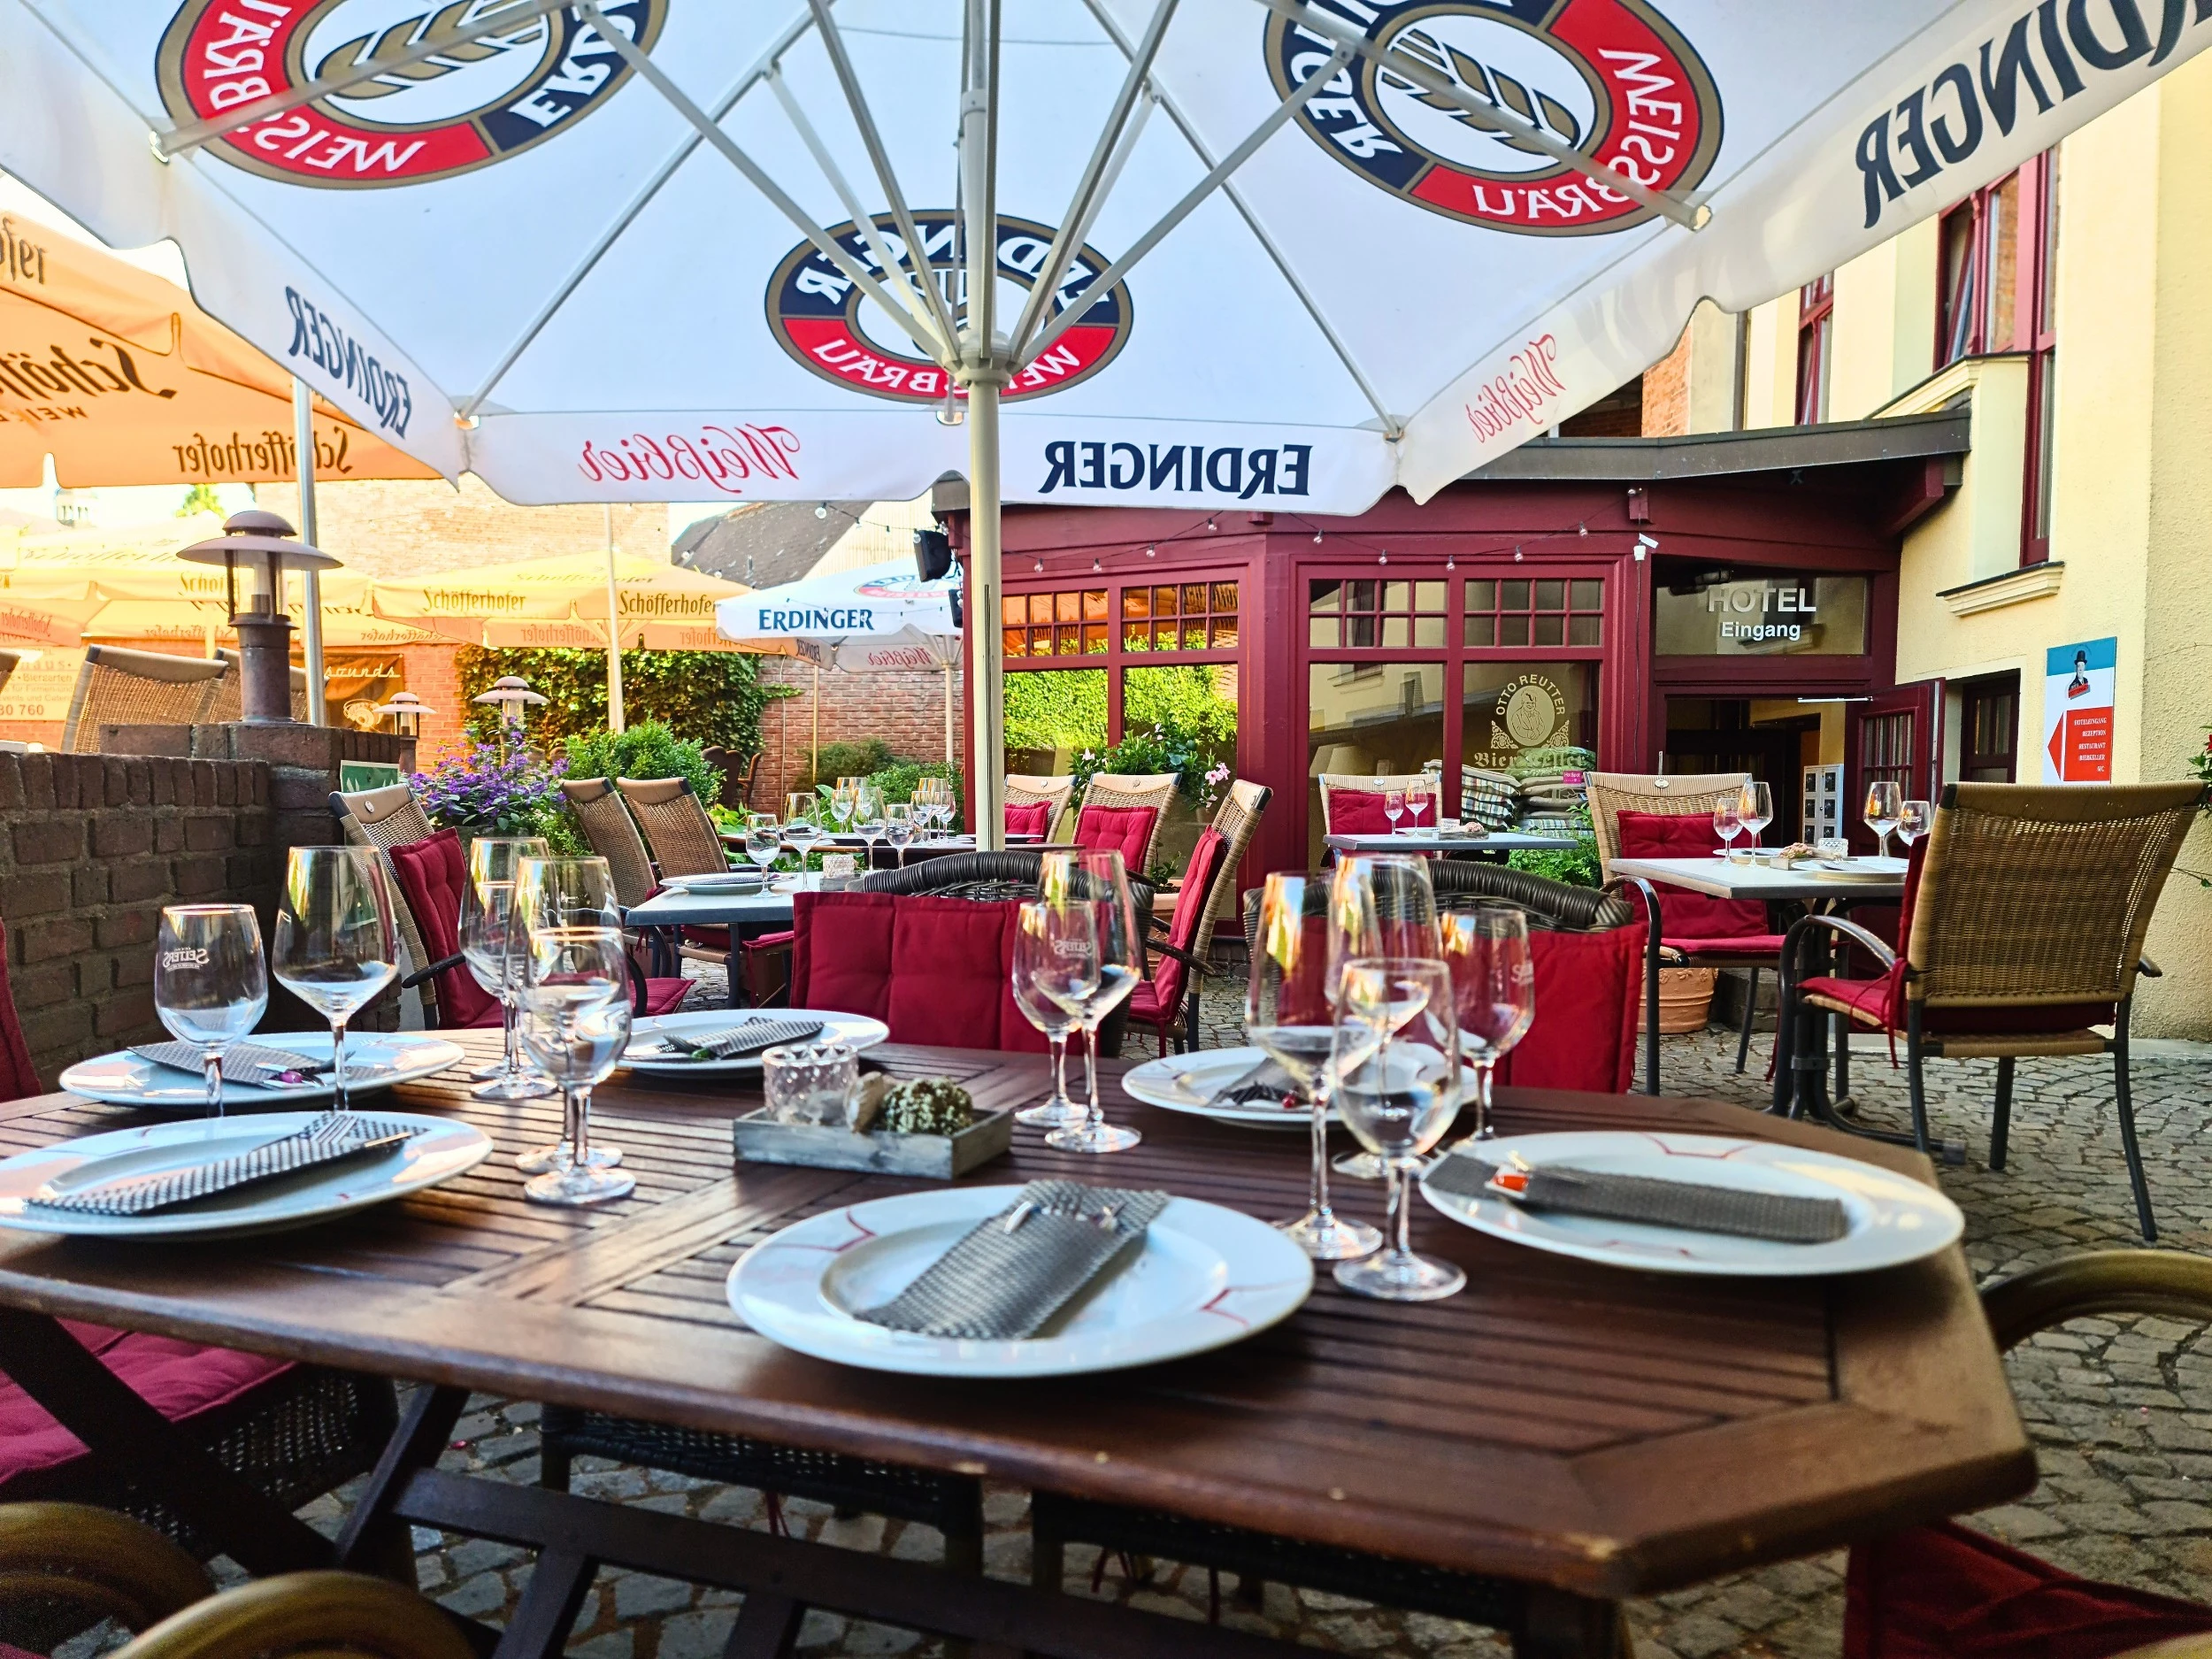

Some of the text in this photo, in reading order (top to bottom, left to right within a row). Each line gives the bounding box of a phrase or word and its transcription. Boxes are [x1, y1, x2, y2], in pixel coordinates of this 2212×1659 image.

[423, 586, 526, 613] Schöfferhofer
[1709, 588, 1816, 612] HOTEL
[759, 609, 875, 632] ERDINGER
[1722, 621, 1801, 641] Eingang
[324, 663, 402, 678] sounds
[1496, 674, 1565, 716] OTTO REUTTER
[19, 704, 44, 716] 760
